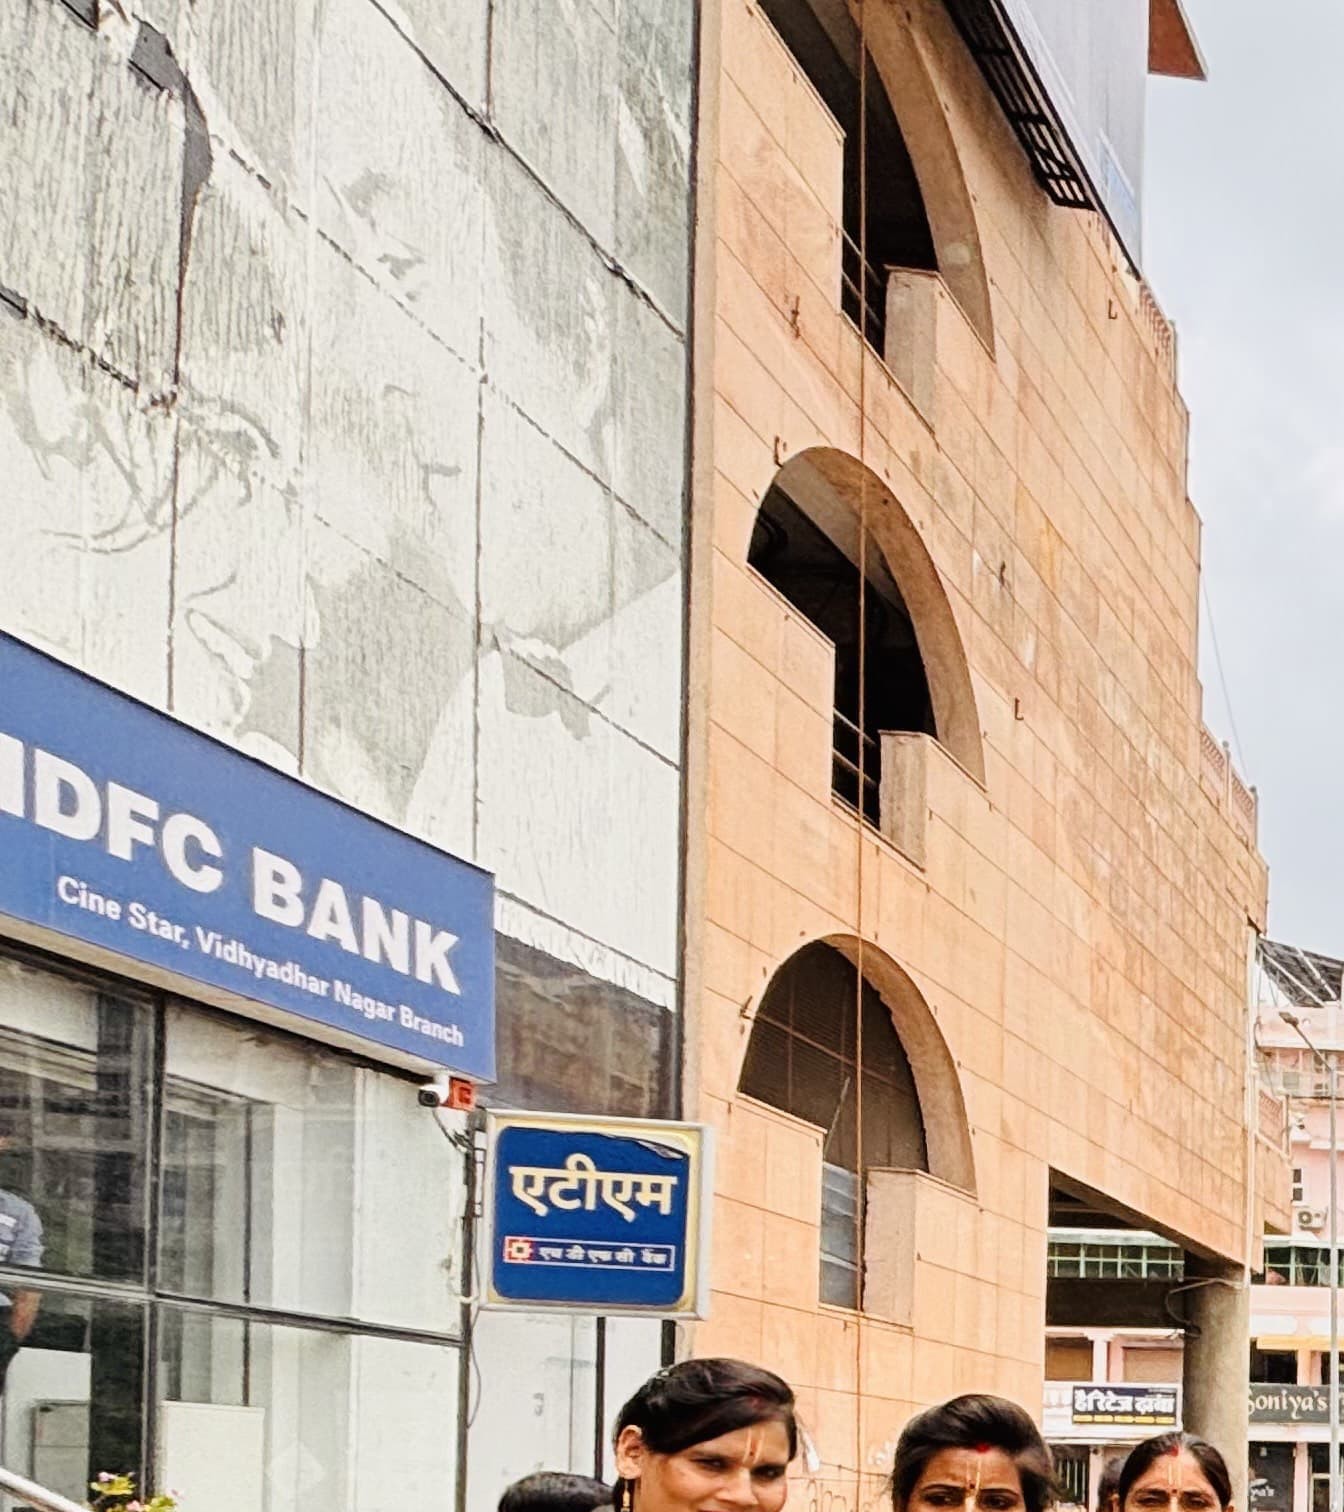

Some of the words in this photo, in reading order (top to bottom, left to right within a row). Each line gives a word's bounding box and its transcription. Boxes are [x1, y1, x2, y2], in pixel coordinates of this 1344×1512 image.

[57, 875, 121, 920] Cine
[127, 902, 190, 949] Star,
[195, 924, 331, 997] Vidhyadhar
[332, 979, 397, 1022] Nagar
[399, 1004, 465, 1048] Branch
[253, 846, 462, 996] BANK
[508, 1153, 678, 1223] एटीएम
